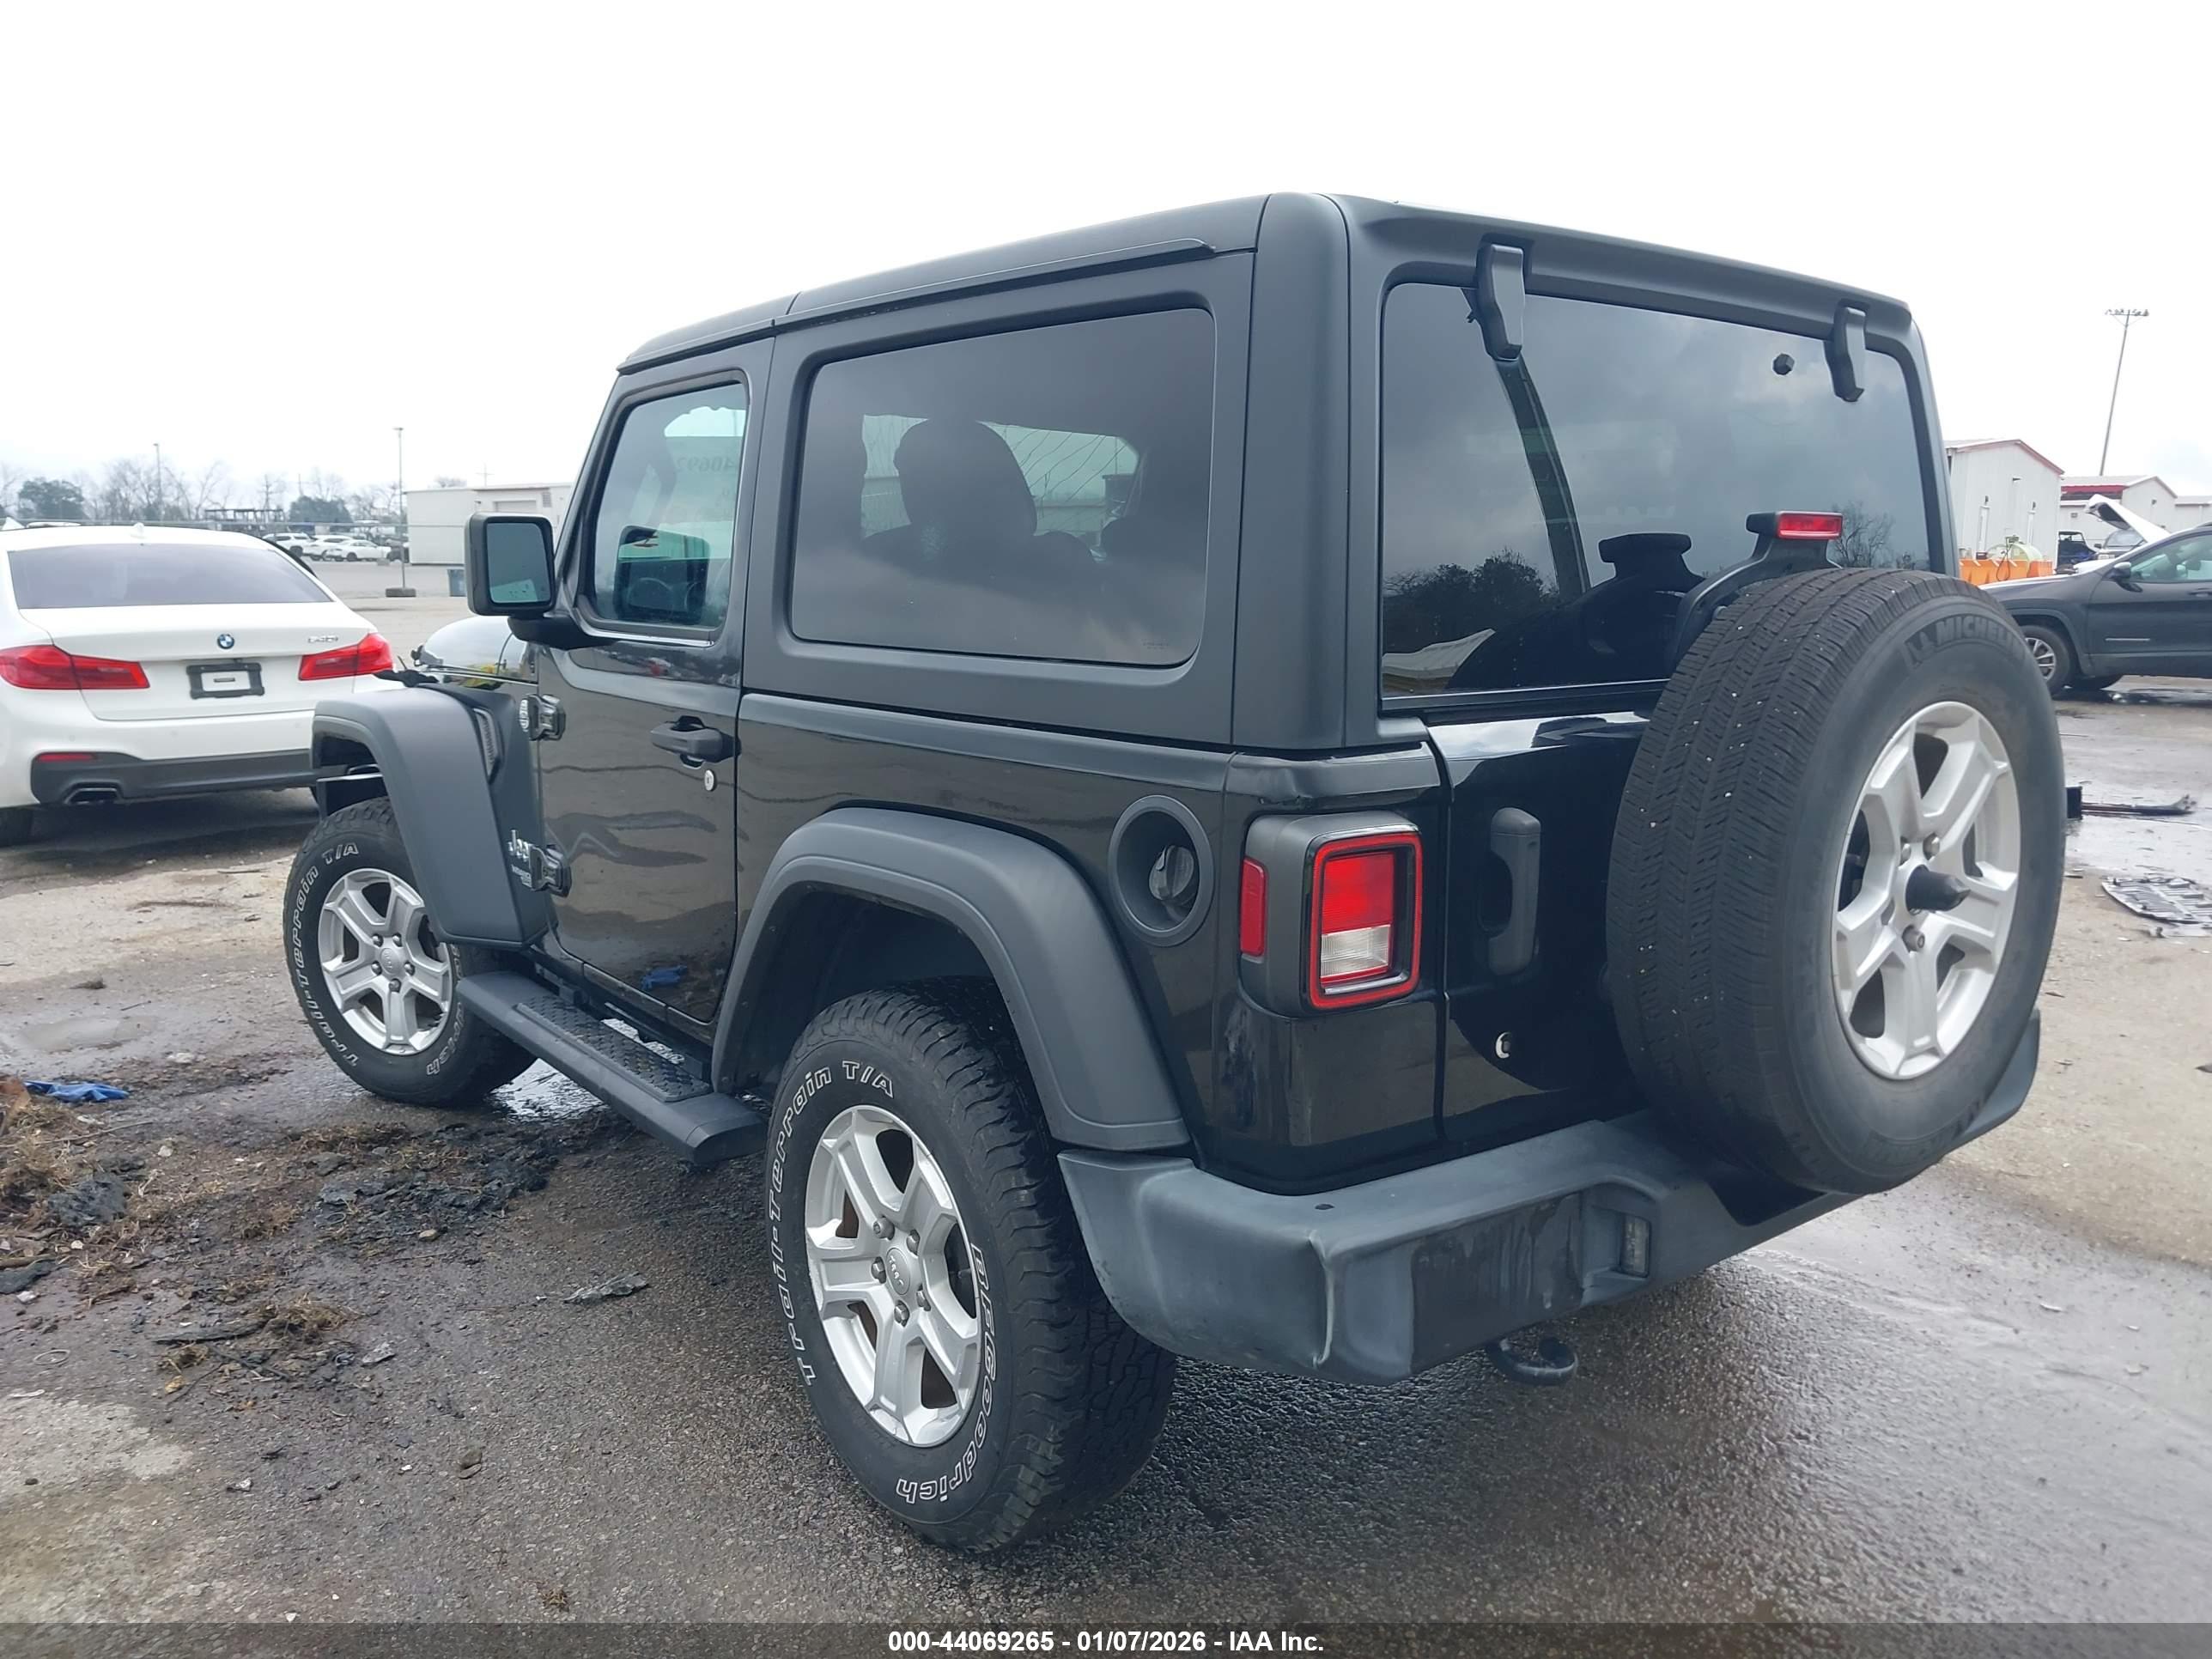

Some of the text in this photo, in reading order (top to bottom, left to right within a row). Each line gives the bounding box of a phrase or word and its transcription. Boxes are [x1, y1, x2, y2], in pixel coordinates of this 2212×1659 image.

[321, 842, 359, 866] T/A
[769, 1060, 895, 1386] Trail-Terrain T/A
[896, 1243, 996, 1504] BFGoodrich
